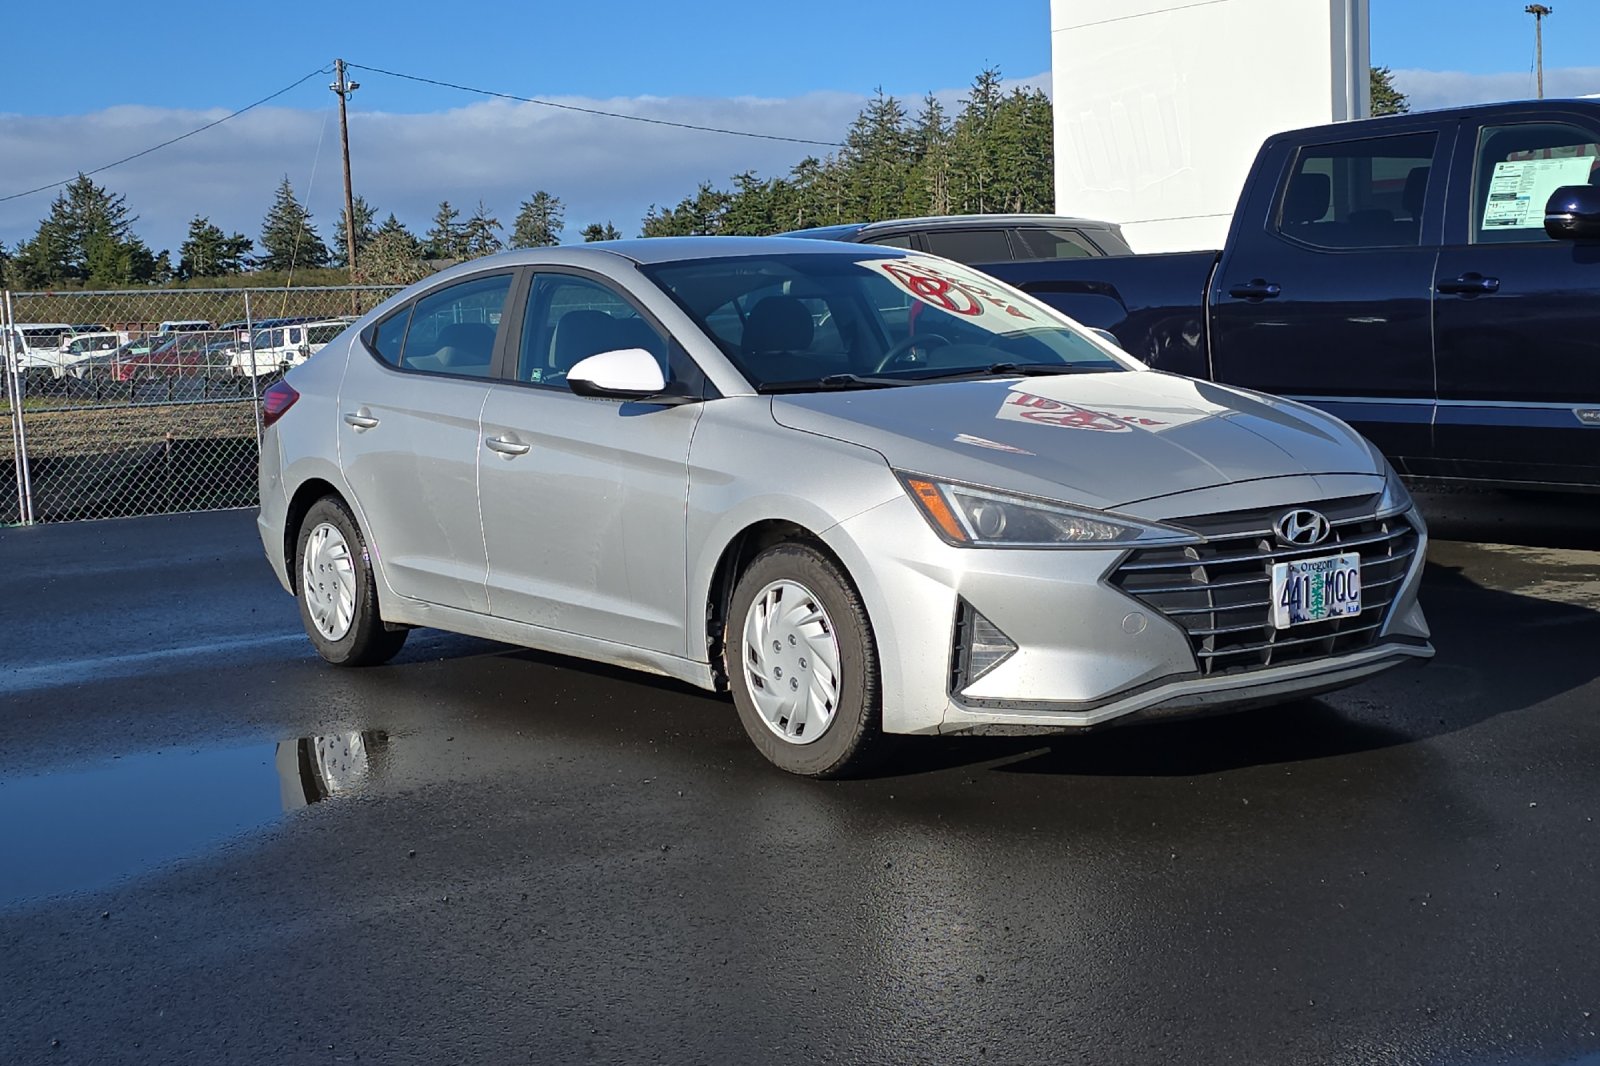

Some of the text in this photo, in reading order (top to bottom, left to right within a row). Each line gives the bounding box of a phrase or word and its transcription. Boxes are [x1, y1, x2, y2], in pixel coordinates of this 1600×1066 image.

[1300, 560, 1333, 572] Oregon
[1281, 570, 1358, 609] 441 MQC
